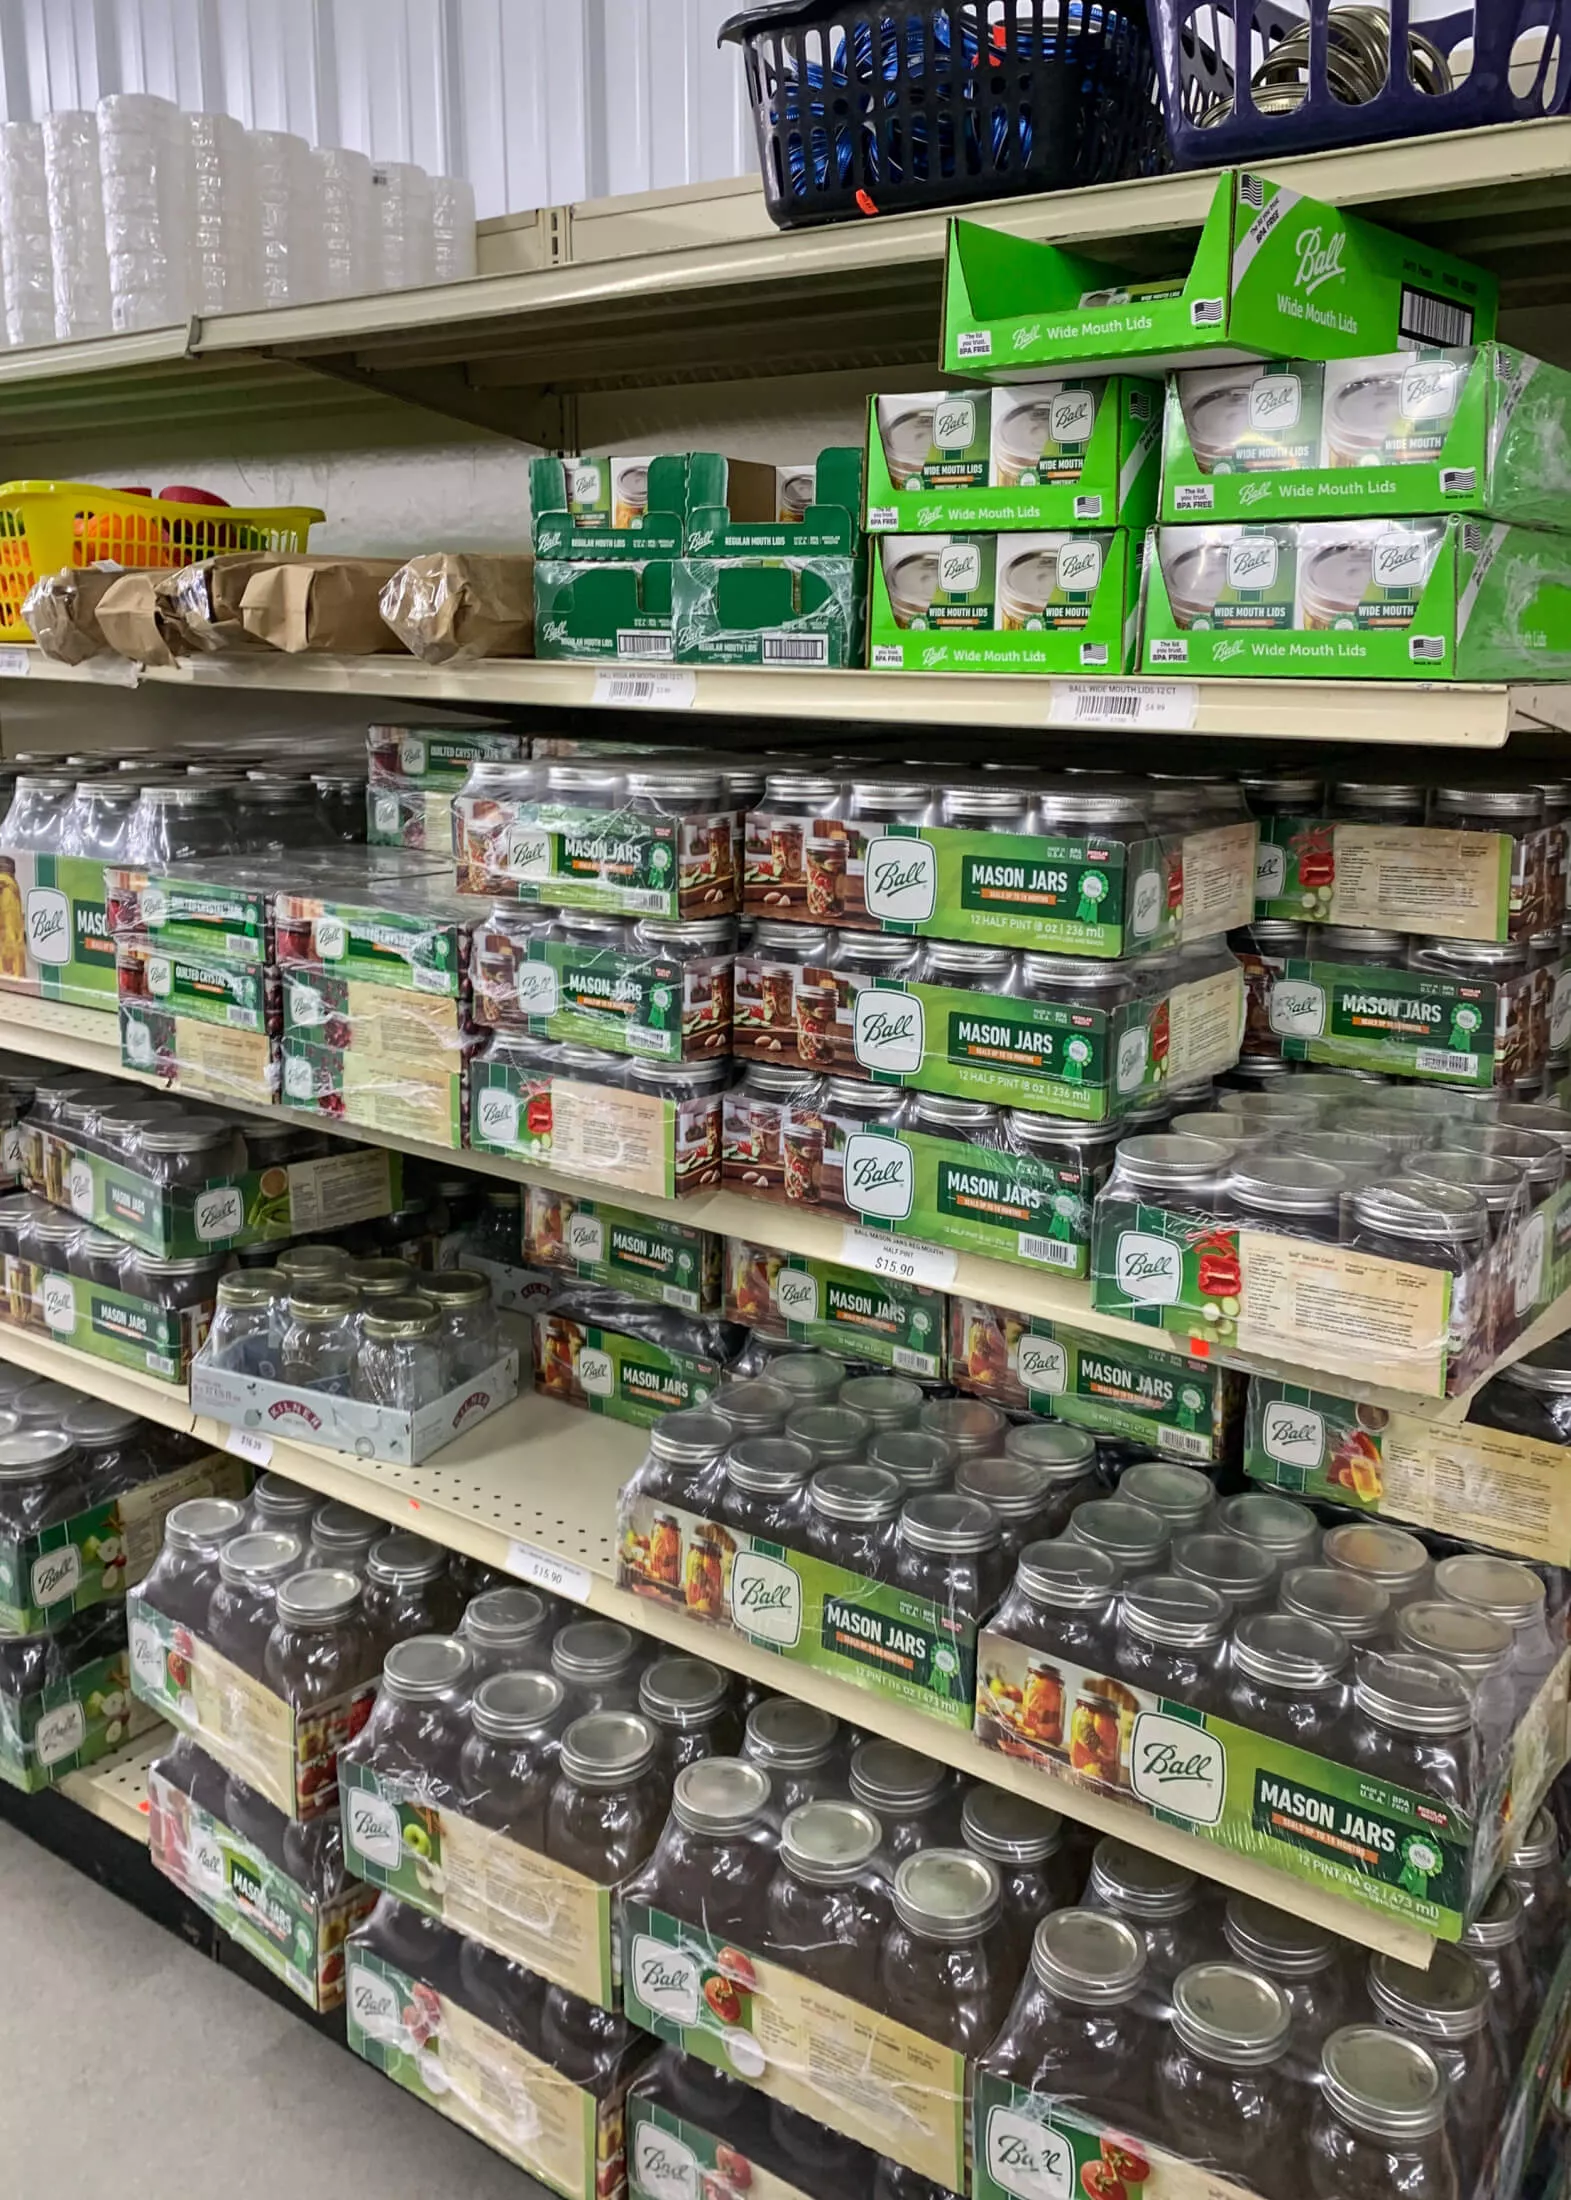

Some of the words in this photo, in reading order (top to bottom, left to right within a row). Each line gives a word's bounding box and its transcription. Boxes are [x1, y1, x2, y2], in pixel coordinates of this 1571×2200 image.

[1294, 226, 1346, 296] Ball
[1277, 294, 1303, 319] Wide
[1305, 303, 1336, 329] Mouth
[1339, 312, 1358, 335] Lids
[1011, 324, 1042, 349] Ball
[1046, 325, 1079, 340] Wide
[1082, 319, 1124, 337] Mouth
[1126, 316, 1153, 331] Lids
[959, 347, 973, 355] BPA
[973, 345, 991, 354] FREE
[1256, 387, 1293, 414] Ball
[939, 411, 969, 436] Ball
[1055, 403, 1087, 429] Ball
[1236, 447, 1256, 460] WIDE
[1258, 446, 1288, 460] MOUTH
[1289, 446, 1310, 459] LIDS
[1385, 438, 1407, 451] WIDE
[1408, 437, 1442, 450] MOUTH
[923, 465, 941, 476] WIDE
[942, 464, 965, 475] MOUTH
[966, 462, 983, 474] LIDS
[1039, 460, 1055, 471] WIDE
[1055, 459, 1083, 470] MOUTH
[1176, 502, 1192, 511] BPA
[1193, 501, 1213, 510] FREE
[1238, 482, 1272, 507] Ball
[1279, 483, 1314, 498] Wide
[1317, 482, 1364, 497] Mouth
[1367, 480, 1396, 494] Lids
[917, 505, 943, 527] Ball
[948, 507, 976, 520] Wide
[978, 507, 1015, 519] Mouth
[1017, 506, 1041, 518] Lids
[538, 531, 561, 553] Ball
[571, 539, 594, 548] REGULAR
[595, 539, 613, 548] MOUTH
[613, 540, 626, 548] LIDS
[688, 530, 714, 552] Ball
[725, 537, 750, 546] REGULAR
[751, 537, 771, 546] MOUTH
[773, 536, 786, 546] LIDS
[944, 556, 976, 581] Ball
[1062, 553, 1096, 578] Ball
[1233, 549, 1272, 577] Ball
[1379, 542, 1421, 574] Ball
[929, 608, 946, 618] WIDE
[947, 607, 970, 617] MOUTH
[972, 607, 988, 617] LIDS
[1214, 607, 1235, 619] WIDE
[1236, 607, 1265, 619] MOUTH
[1266, 607, 1286, 618] LIDS
[1358, 605, 1380, 617] WIDE
[1382, 605, 1414, 616] MOUTH
[922, 646, 948, 666] Ball
[953, 649, 981, 662] Wide
[984, 650, 1021, 662] Mouth
[1023, 650, 1046, 662] Lids
[1152, 654, 1167, 662] BPA
[1169, 654, 1188, 662] FREE
[1212, 640, 1246, 661] Ball
[1251, 643, 1287, 657] Wide
[1289, 643, 1336, 658] Mouth
[1337, 643, 1366, 657] Lids
[1069, 685, 1087, 693] BALL
[1089, 685, 1107, 694] WIDE
[1109, 685, 1136, 695] MOUTH
[1137, 686, 1155, 695] LIDS
[1156, 687, 1165, 695] 12
[1166, 687, 1176, 695] CT
[514, 842, 545, 867] Ball
[565, 838, 608, 860] MASON
[608, 844, 642, 863] JARS
[874, 860, 929, 898] Ball
[972, 864, 1024, 889] MASON
[1028, 869, 1068, 893] JARS
[31, 909, 64, 943] Ball
[569, 974, 610, 997] MASON
[610, 981, 642, 1002] JARS
[1342, 994, 1400, 1017] MASON
[1401, 1000, 1442, 1023] JARS
[862, 1014, 917, 1046] Ball
[958, 1021, 1010, 1048] MASON
[1014, 1030, 1053, 1055] JARS
[958, 1070, 969, 1081] 12
[969, 1072, 995, 1085] HALF
[998, 1077, 1019, 1089] PINT
[1032, 1084, 1044, 1094] oz
[1053, 1086, 1070, 1098] 236
[482, 1103, 514, 1125] Ball
[853, 1157, 905, 1192] Ball
[948, 1171, 999, 1200] MASON
[1002, 1183, 1041, 1210] JARS
[201, 1197, 236, 1228] Ball
[573, 1224, 598, 1246] Ball
[613, 1232, 647, 1256] MASON
[649, 1243, 674, 1264] JARS
[854, 1228, 869, 1237] BALL
[869, 1232, 891, 1243] MASON
[892, 1238, 908, 1247] JARS
[909, 1241, 920, 1250] REG
[921, 1245, 944, 1256] MOUTH
[883, 1246, 898, 1255] HALF
[899, 1250, 914, 1258] PINT
[874, 1256, 914, 1277] $15.90
[1125, 1252, 1174, 1281] Ball
[781, 1285, 812, 1305] Ball
[829, 1289, 872, 1316] MASON
[874, 1300, 906, 1324] JARS
[101, 1305, 127, 1326] MASON
[128, 1314, 147, 1333] JARS
[582, 1360, 608, 1381] Ball
[1022, 1351, 1059, 1375] Ball
[623, 1367, 660, 1391] MASON
[662, 1377, 689, 1398] JARS
[1081, 1359, 1132, 1390] MASON
[1135, 1375, 1173, 1401] JARS
[1271, 1420, 1317, 1447] Ball
[38, 1555, 73, 1594] Ball
[533, 1564, 562, 1584] $15.90
[740, 1576, 793, 1614] Ball
[827, 1603, 882, 1643] MASON
[885, 1627, 927, 1660] JARS
[1142, 1740, 1214, 1783] Ball
[1360, 1790, 1386, 1805] U.S.A.
[1391, 1803, 1410, 1813] FREE
[1392, 1795, 1411, 1807] BPA
[1260, 1780, 1334, 1829] MASON
[1339, 1813, 1396, 1852] JARS
[1282, 1816, 1302, 1831] SEALS
[1338, 1836, 1366, 1856] MONTHS
[1299, 1854, 1311, 1867] 12
[1312, 1859, 1339, 1880] PINT
[1364, 1881, 1380, 1894] oz
[1389, 1889, 1413, 1908] 473
[1415, 1900, 1440, 1919] ml)
[641, 1959, 691, 1997] Ball
[355, 1985, 392, 2016] Ball
